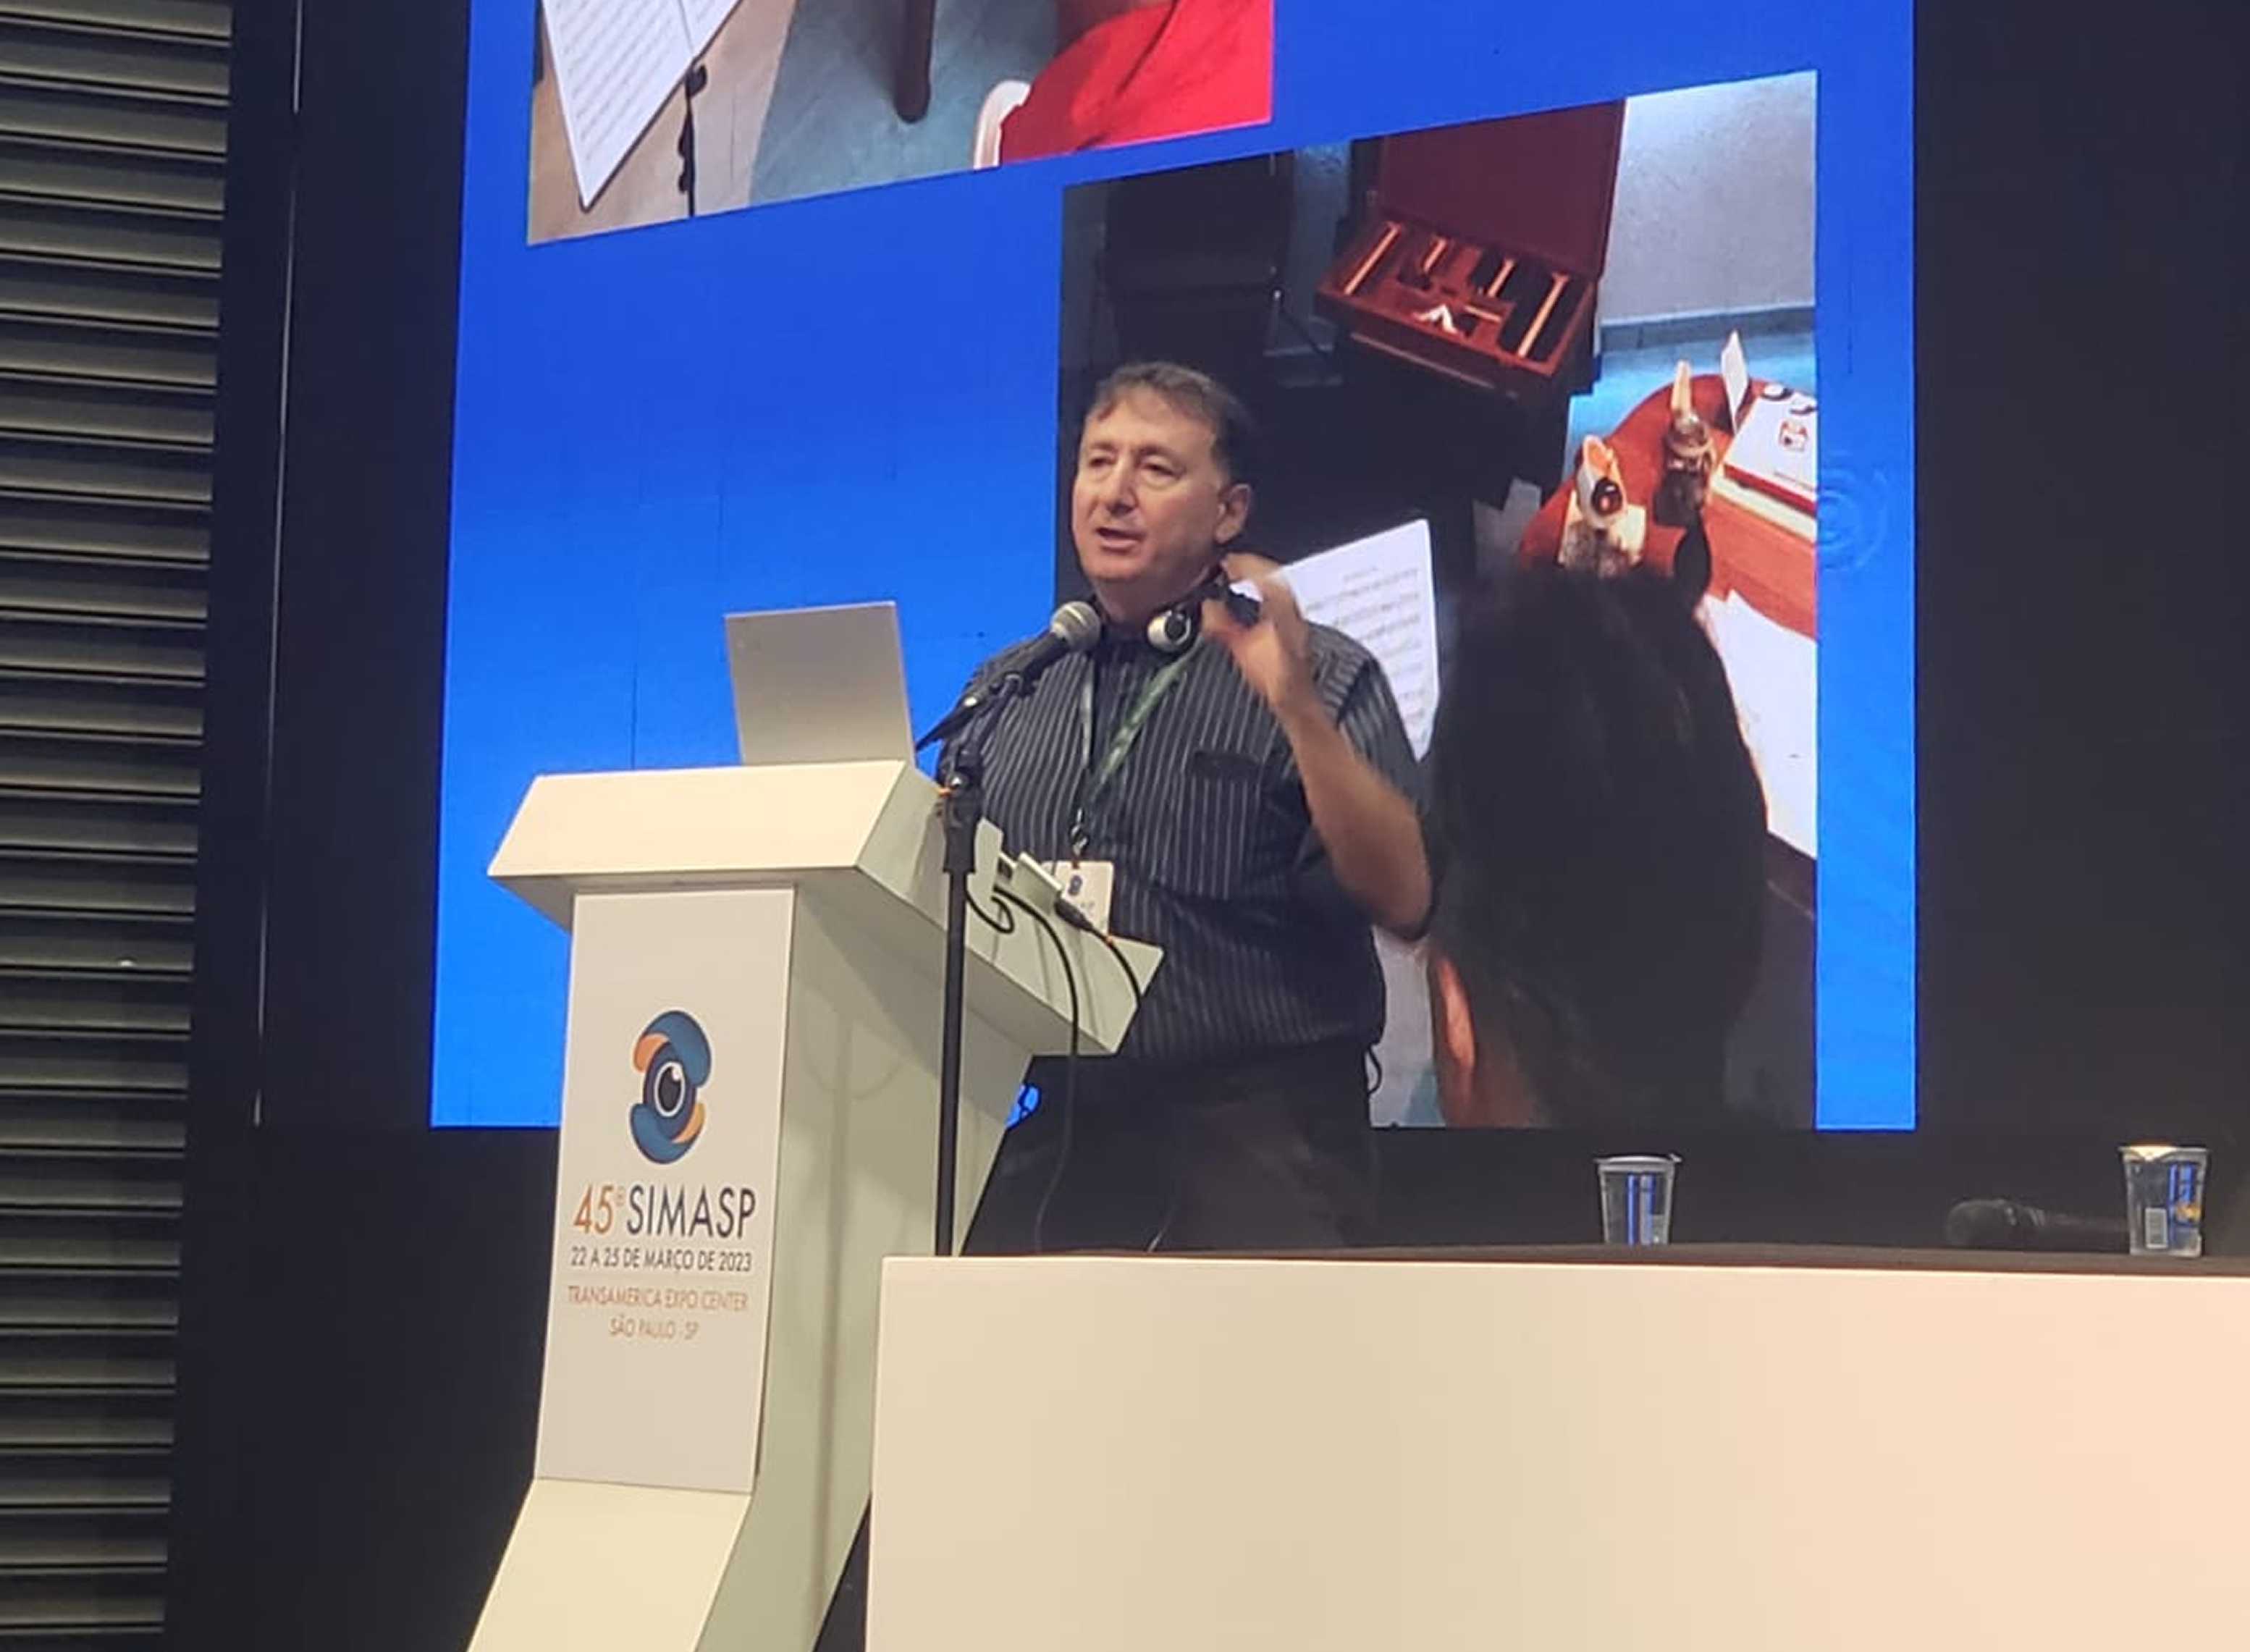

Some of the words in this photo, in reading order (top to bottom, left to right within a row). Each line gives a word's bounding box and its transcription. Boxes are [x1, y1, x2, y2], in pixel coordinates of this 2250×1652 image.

[626, 1184, 757, 1239] SIMASP
[571, 1246, 587, 1266] 22
[590, 1247, 600, 1267] A
[603, 1247, 620, 1268] 25
[623, 1247, 641, 1268] DE
[643, 1248, 695, 1273] MARÇO
[697, 1250, 716, 1271] DE
[718, 1251, 752, 1272] 2023
[568, 1286, 662, 1307] TRANSAMERICA
[665, 1288, 699, 1310] EXPO
[701, 1290, 749, 1312] CENTER
[610, 1314, 635, 1337] SÃO
[639, 1318, 676, 1339] PAULO
[684, 1320, 699, 1341] SP
